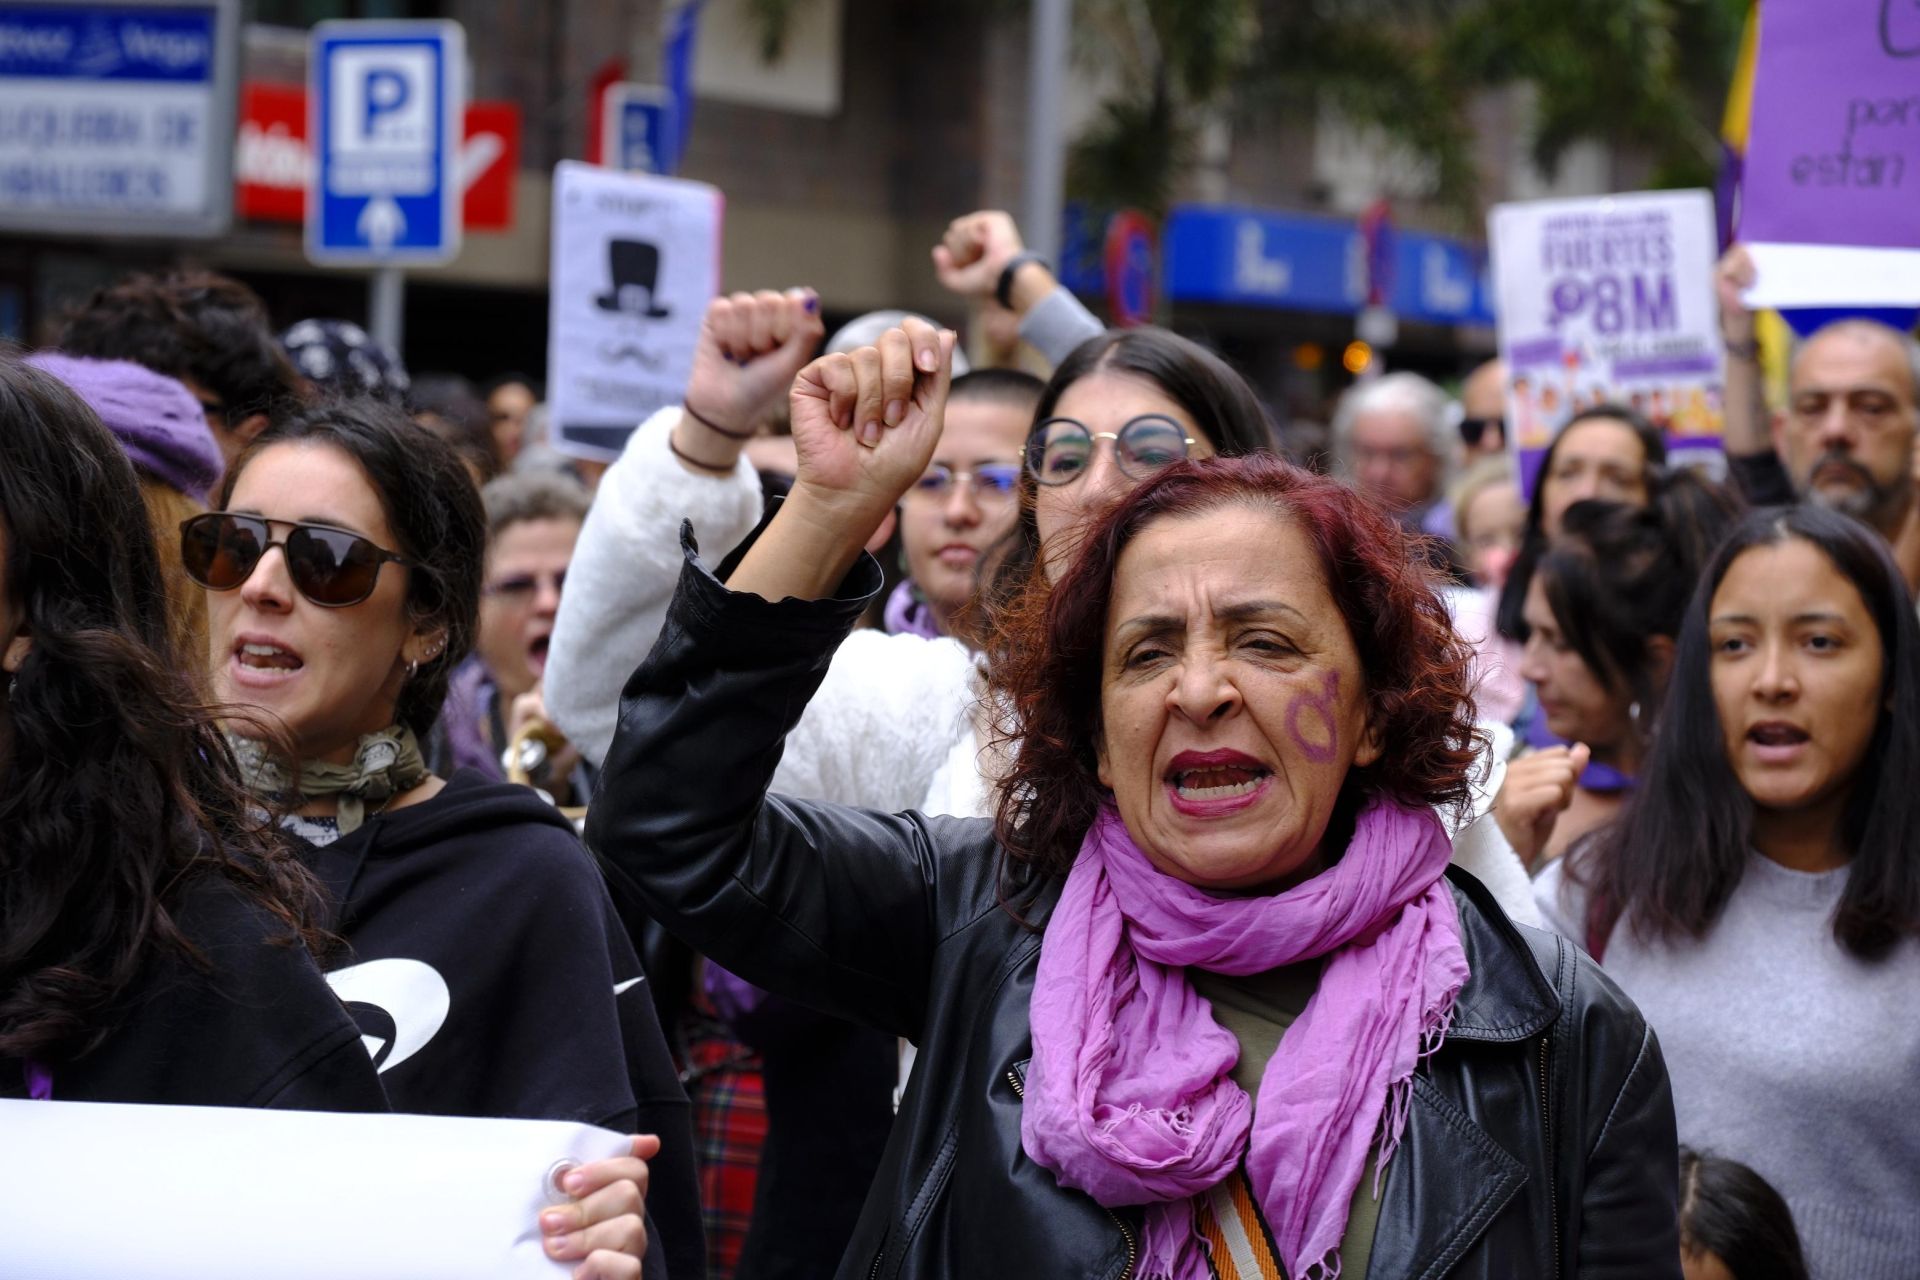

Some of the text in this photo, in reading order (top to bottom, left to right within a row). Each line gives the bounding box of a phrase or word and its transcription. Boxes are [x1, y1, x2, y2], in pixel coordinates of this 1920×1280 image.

[362, 69, 411, 139] P
[1542, 230, 1674, 274] FUERTES
[1593, 272, 1677, 336] 8M
